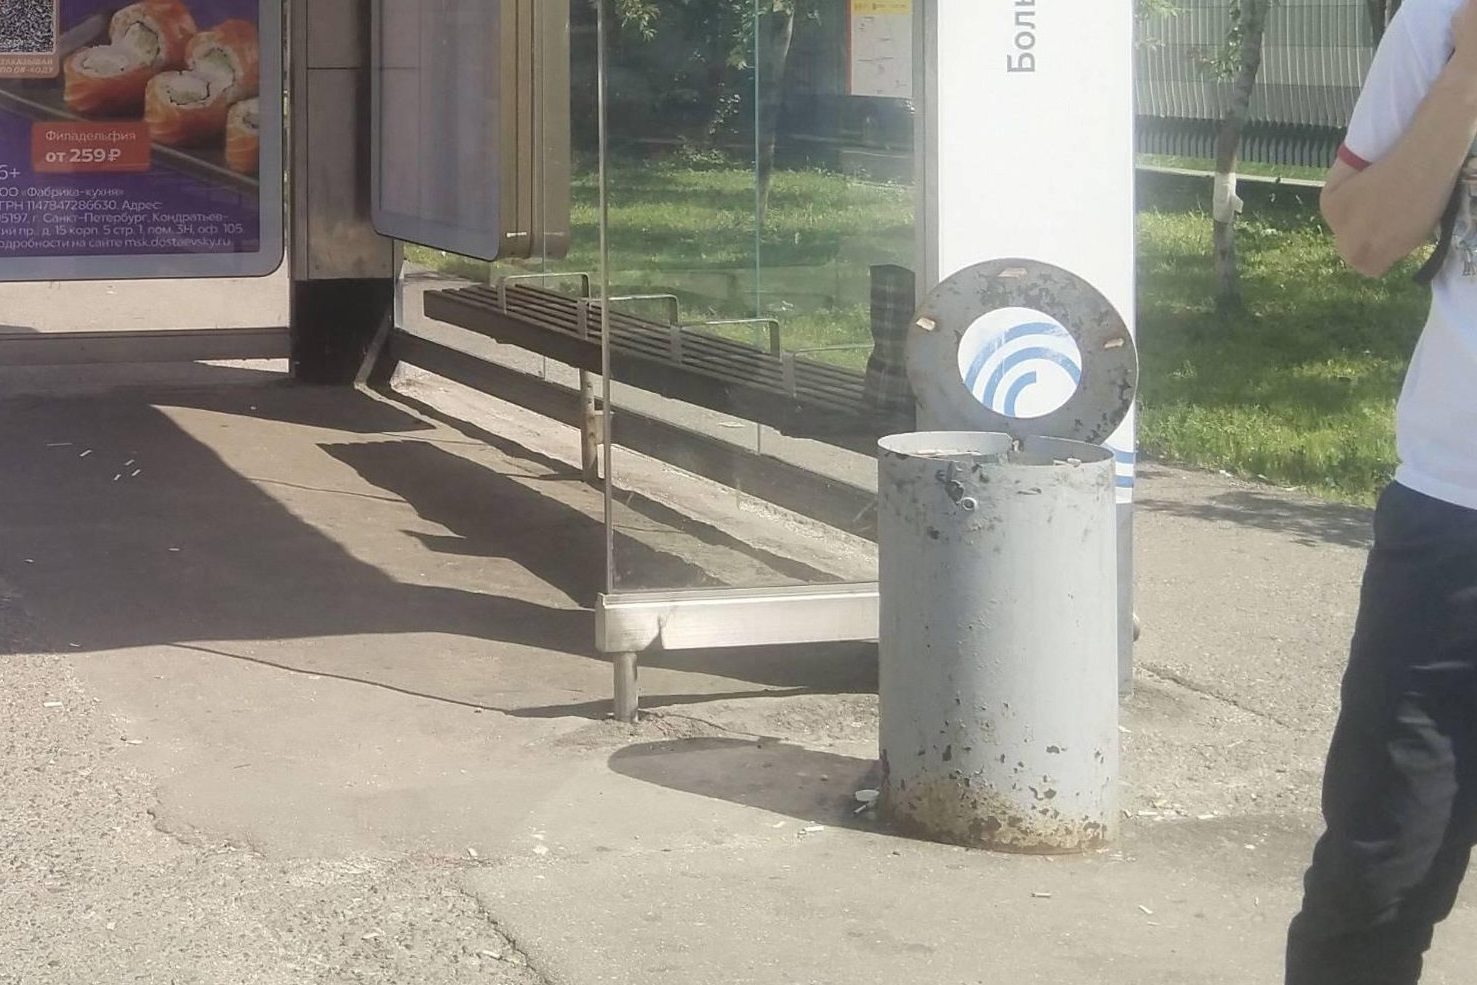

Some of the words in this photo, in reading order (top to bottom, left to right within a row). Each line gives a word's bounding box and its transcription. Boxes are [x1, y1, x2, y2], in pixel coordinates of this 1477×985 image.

[45, 130, 136, 143] Филадельфия
[45, 152, 66, 163] от
[55, 224, 67, 235] 15
[103, 224, 111, 235] 5
[71, 238, 87, 248] на
